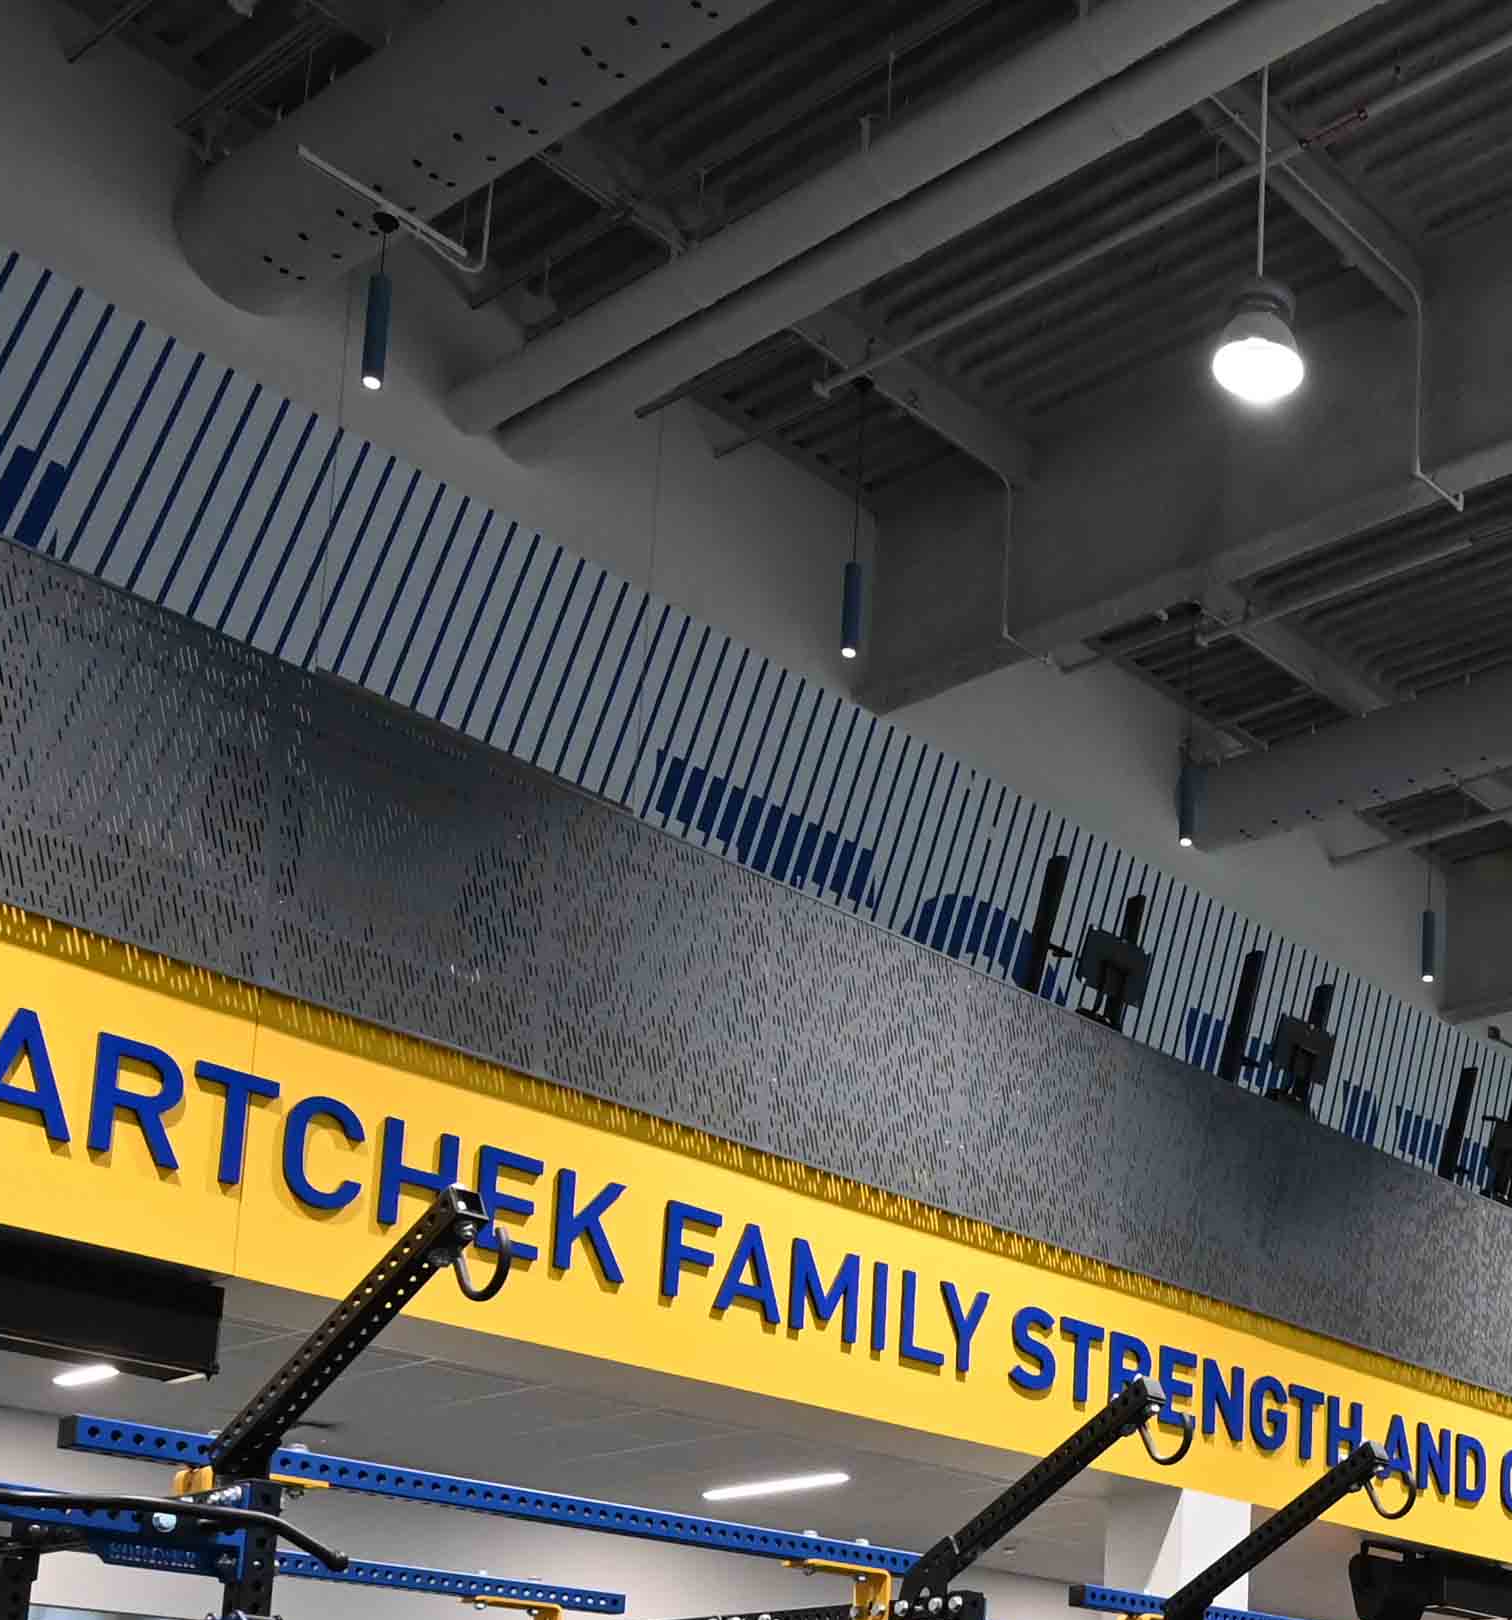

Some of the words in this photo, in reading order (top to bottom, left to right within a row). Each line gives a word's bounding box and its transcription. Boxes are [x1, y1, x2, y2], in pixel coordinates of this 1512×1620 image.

[661, 1199, 990, 1373] FAMILY
[1008, 1306, 1364, 1468] STRENGTH
[1383, 1414, 1486, 1503] AND
